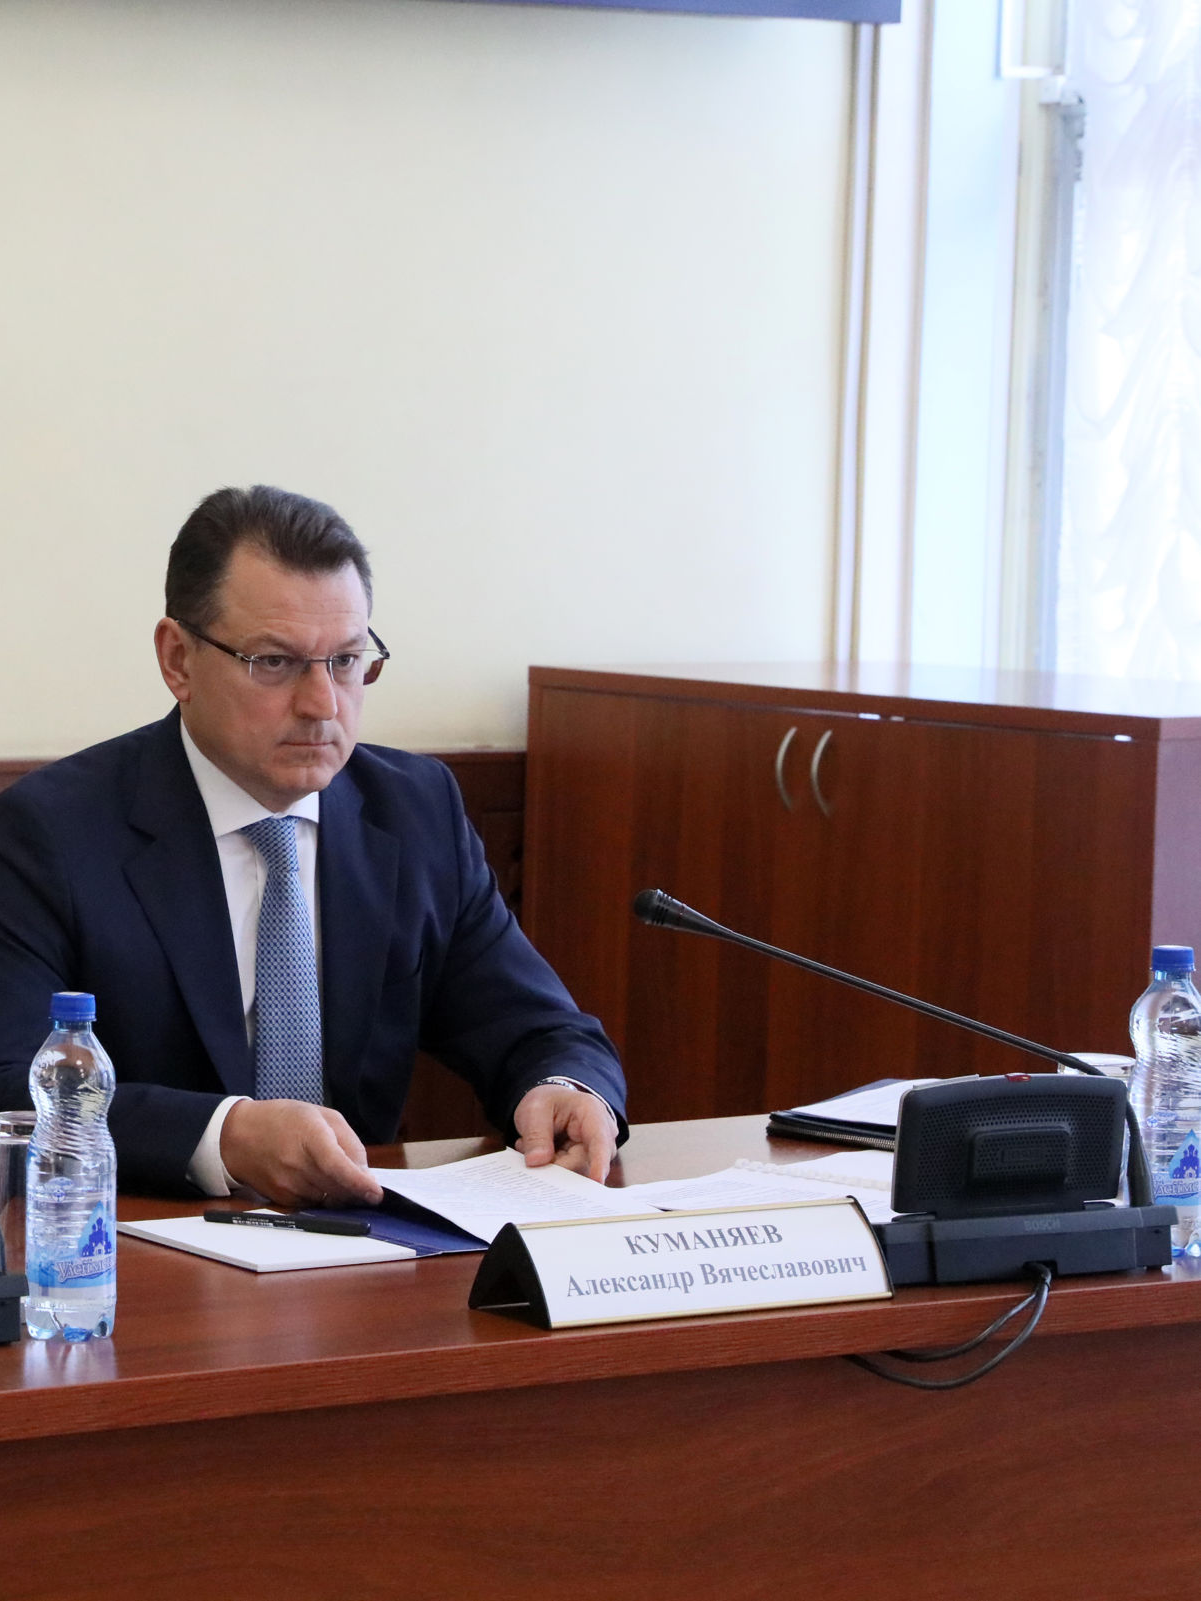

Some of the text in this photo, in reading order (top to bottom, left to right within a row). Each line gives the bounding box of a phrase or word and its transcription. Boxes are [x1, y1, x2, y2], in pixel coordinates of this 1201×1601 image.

[624, 1223, 783, 1256] КУМАНЯЕВ
[1024, 1217, 1061, 1231] BOSCH
[566, 1254, 868, 1298] Александр Вячеславович
